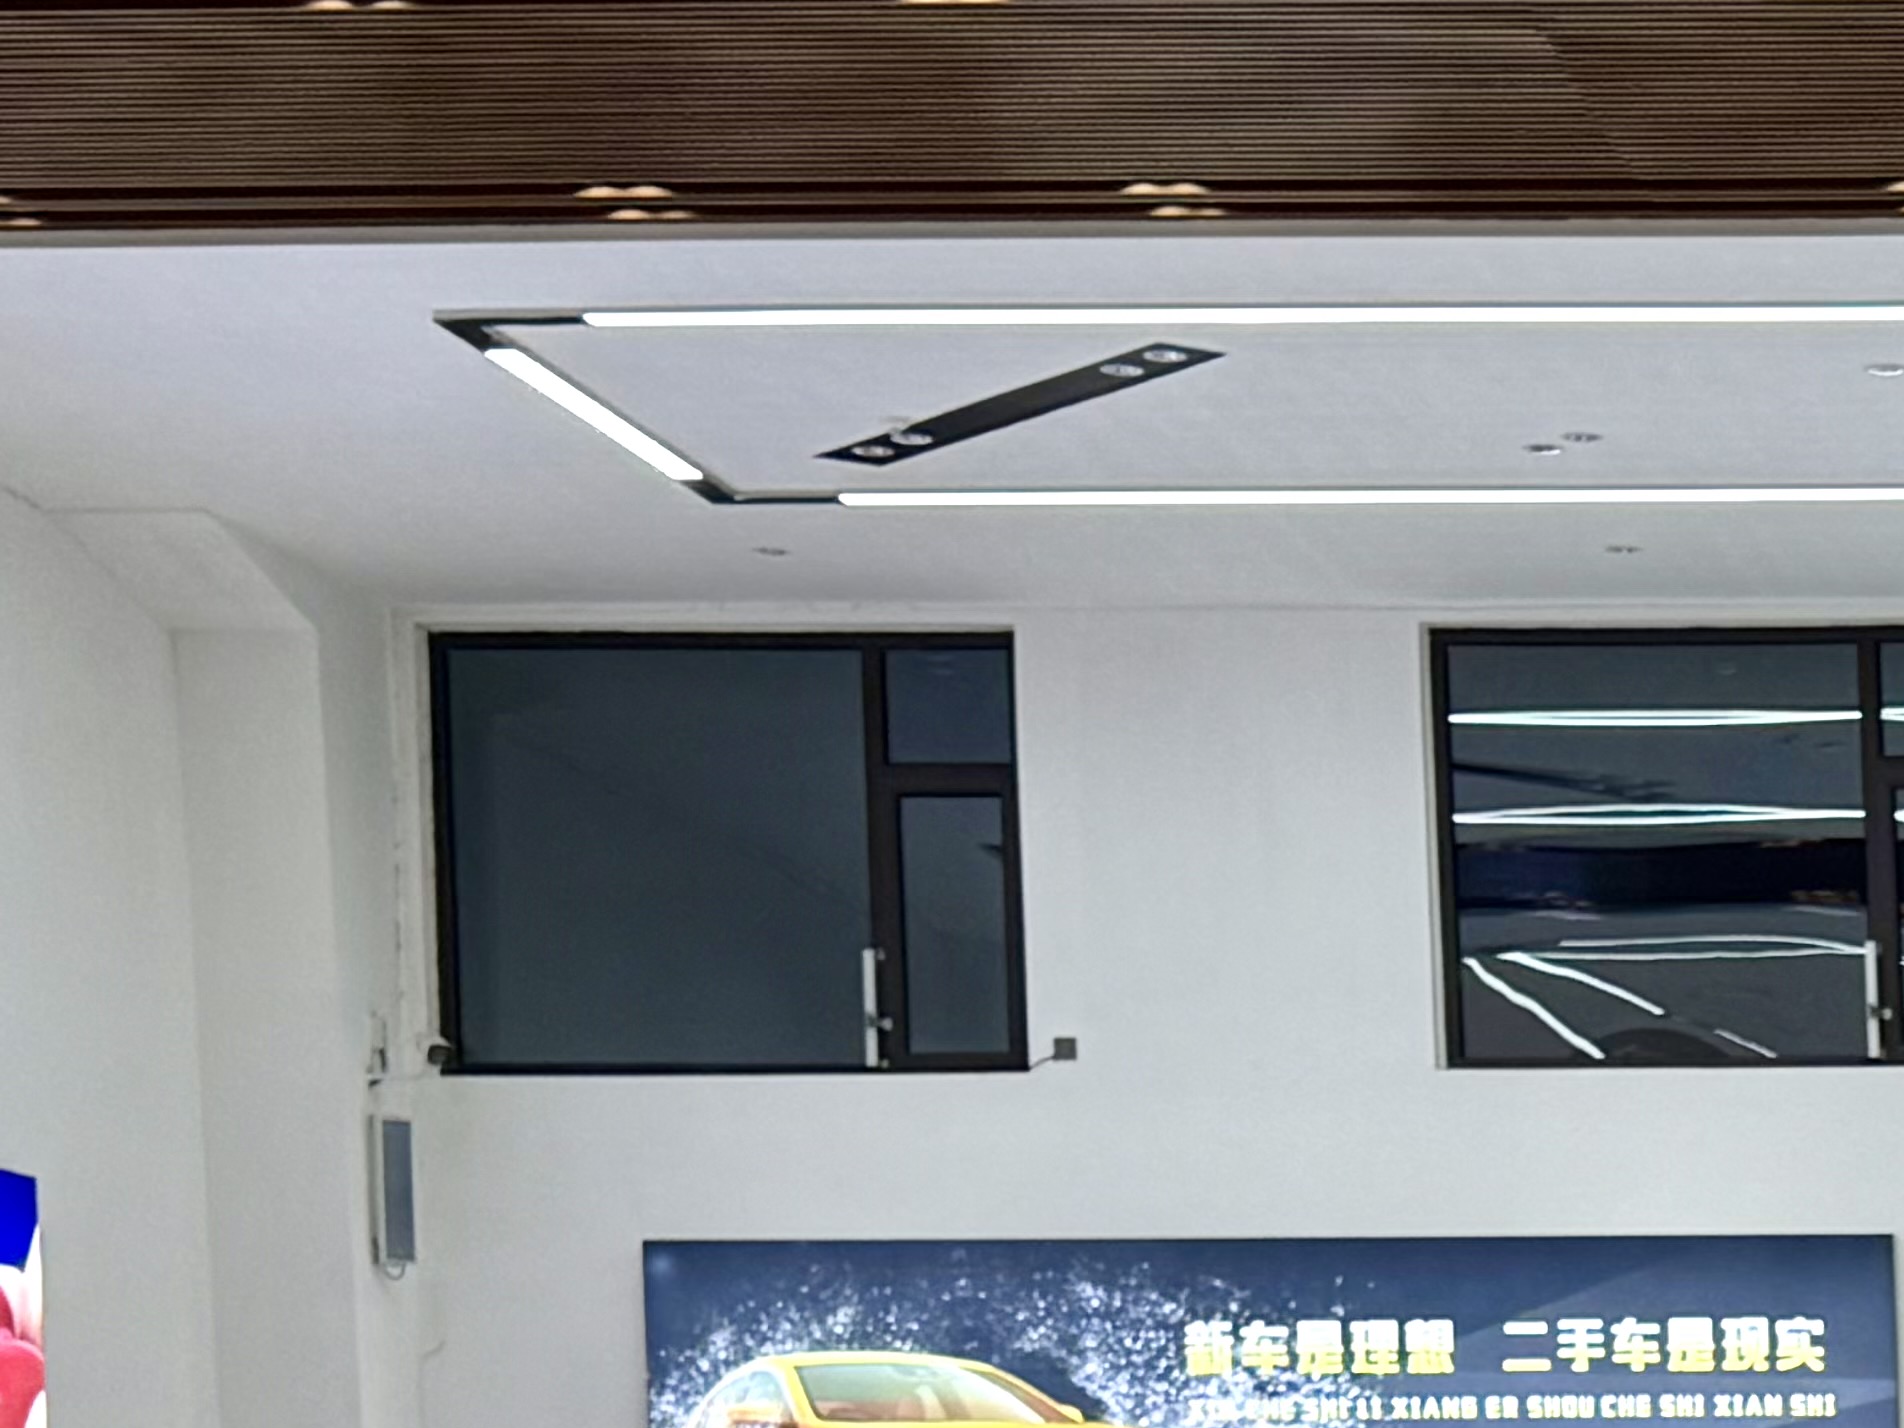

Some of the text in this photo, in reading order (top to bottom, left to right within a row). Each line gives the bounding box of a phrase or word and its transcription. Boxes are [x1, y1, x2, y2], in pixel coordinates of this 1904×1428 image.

[1184, 1315, 1827, 1376] 新车是理想 二手车是现实
[1390, 1396, 1478, 1420] XIANG
[1485, 1396, 1519, 1419] ER
[1526, 1395, 1595, 1419] SHOU
[1601, 1394, 1652, 1418] CHE
[1659, 1393, 1705, 1418] SHI
[1713, 1394, 1783, 1418] XIAN
[1789, 1392, 1837, 1418] SHI
